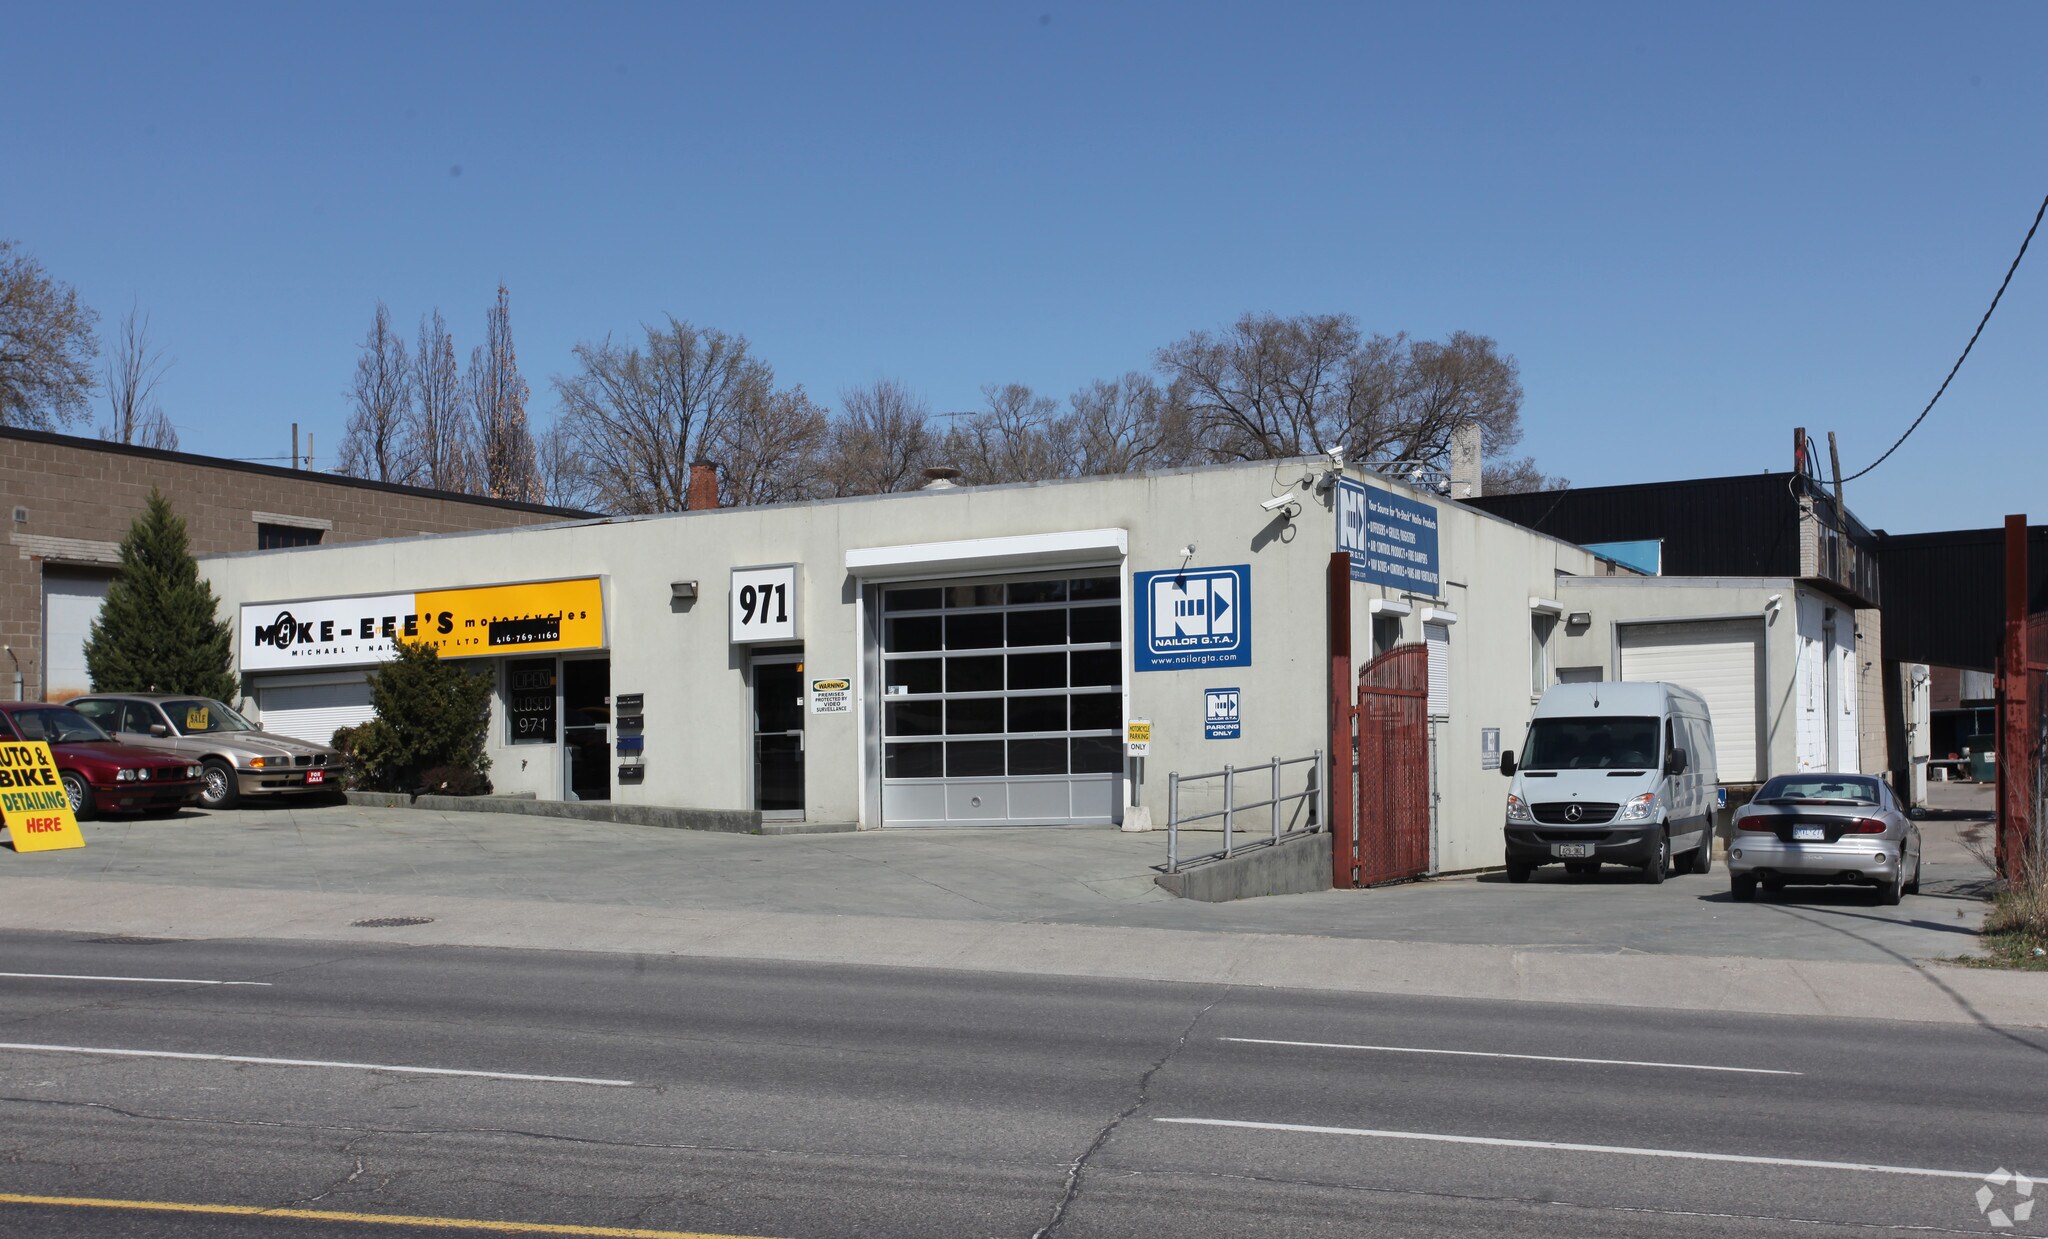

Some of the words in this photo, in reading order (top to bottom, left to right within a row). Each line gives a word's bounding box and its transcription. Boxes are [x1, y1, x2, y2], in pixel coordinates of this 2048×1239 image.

[739, 583, 787, 625] 971
[291, 646, 346, 657] MICHAEL
[456, 638, 479, 646] LTD
[1155, 637, 1198, 647] NAILOR
[1201, 635, 1233, 644] G.T.A.
[1151, 653, 1237, 665] www.nailorgta.com
[516, 671, 549, 687] OPEN
[818, 682, 844, 690] WARNING
[513, 696, 551, 712] CLOSED
[519, 717, 547, 733] 971
[1130, 743, 1147, 751] ONLY
[35, 746, 49, 766] &
[0, 768, 56, 788] BIKE
[2, 791, 67, 812] DETAILING
[26, 817, 62, 833] HERE
